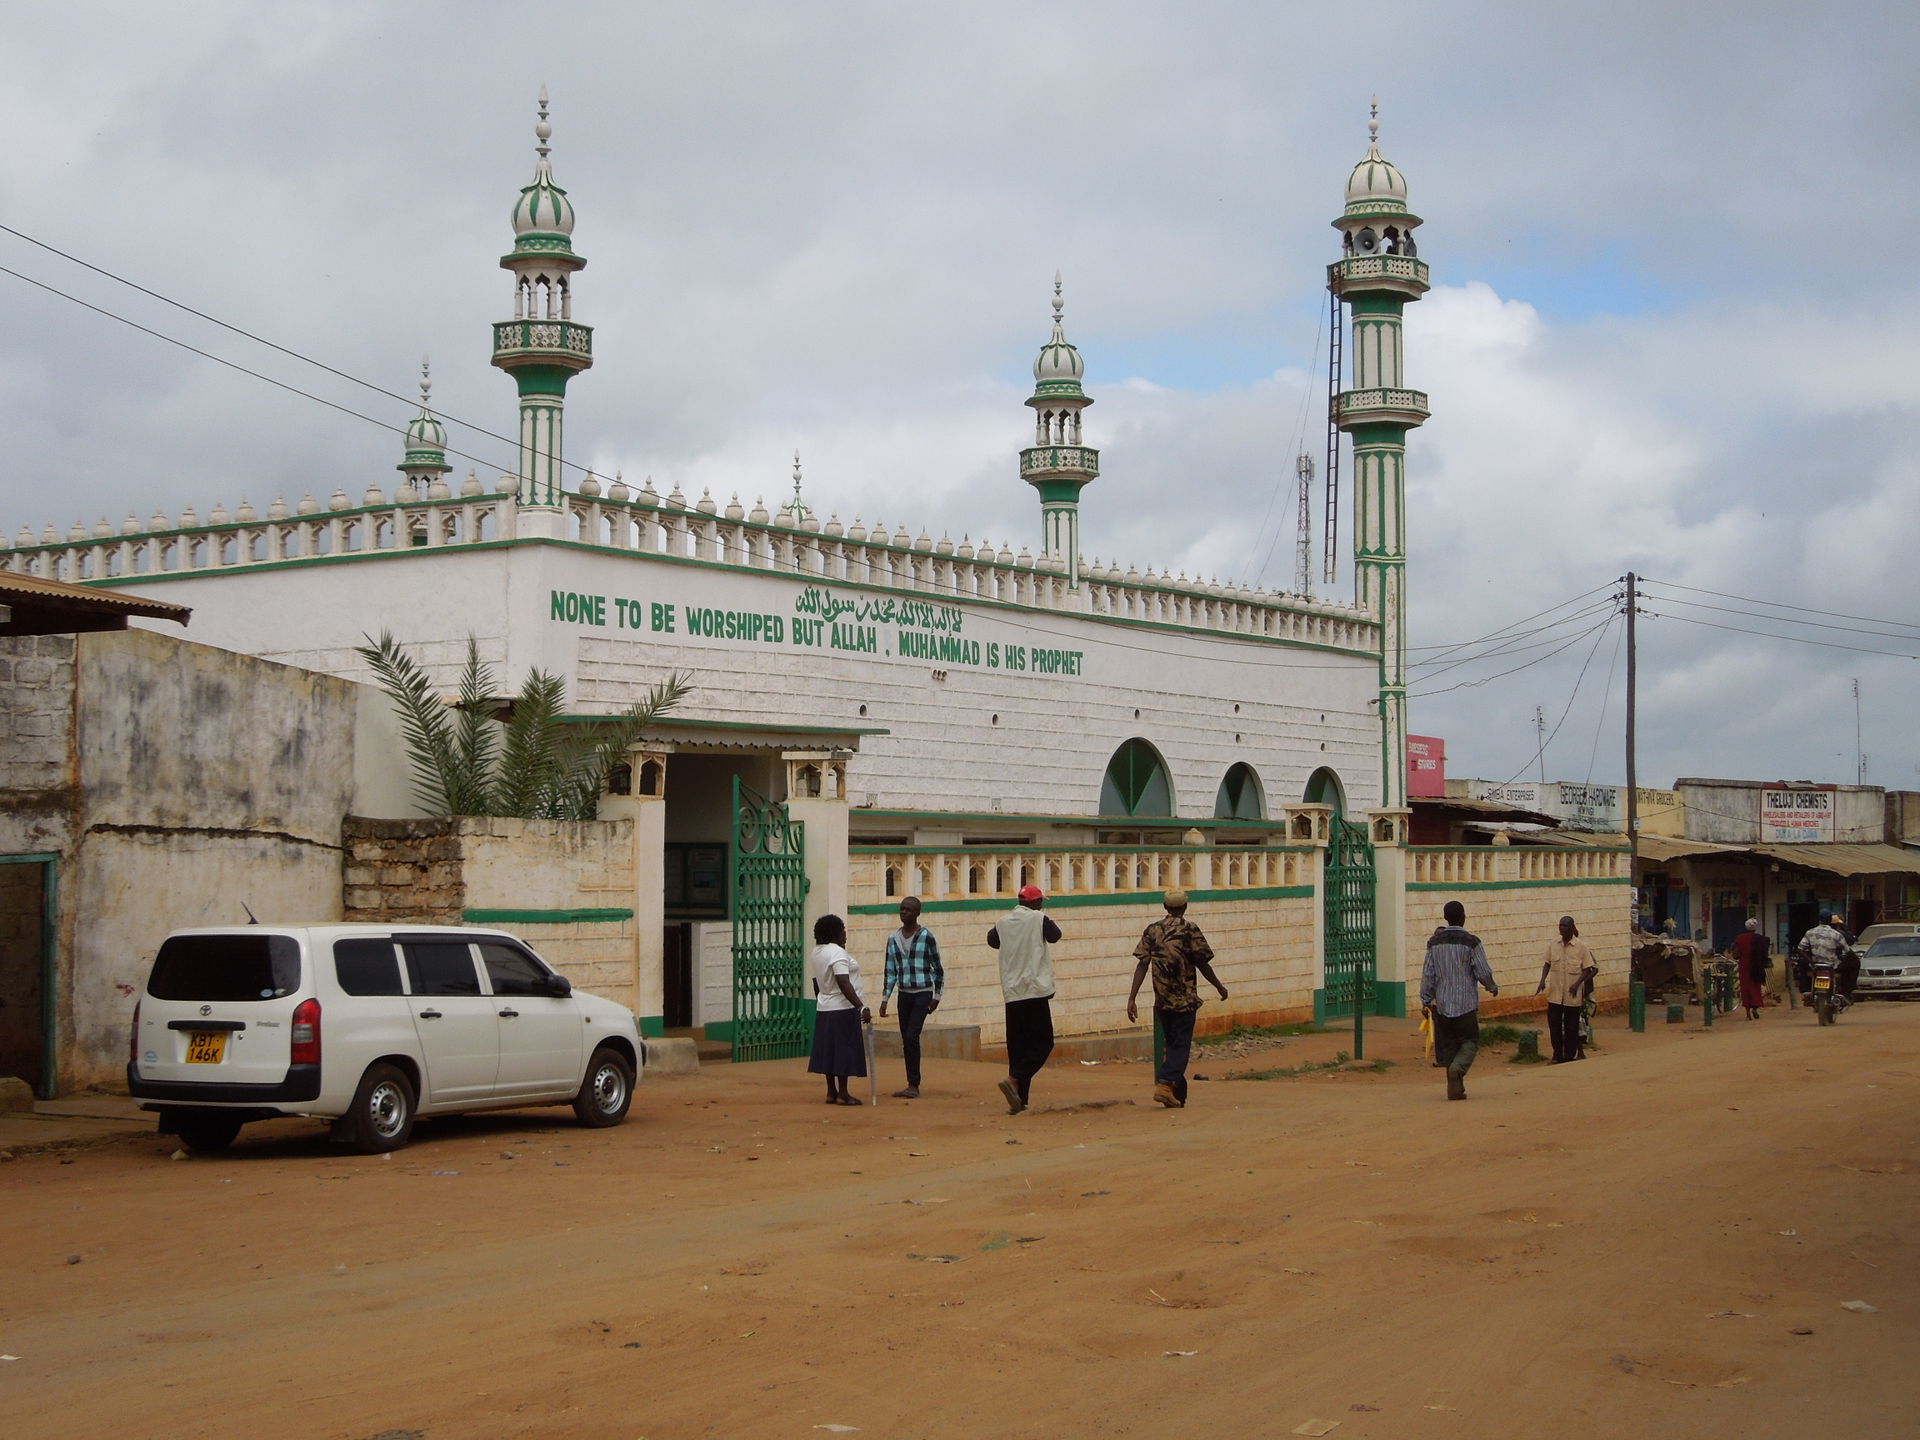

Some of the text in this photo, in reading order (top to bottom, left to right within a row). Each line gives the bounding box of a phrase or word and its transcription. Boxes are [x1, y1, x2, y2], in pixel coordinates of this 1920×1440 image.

[551, 590, 606, 626] NONE
[614, 598, 641, 629] TO
[651, 602, 675, 633] BE
[685, 606, 784, 643] WORSHIPED
[792, 617, 824, 647] BUT
[899, 631, 980, 666] MUHAMMAD
[986, 642, 1000, 668] IS
[1005, 644, 1026, 671] HIS
[1031, 648, 1084, 676] PROPHET
[1766, 792, 1828, 809] THELUJI CHEMISTS
[190, 1033, 215, 1047] KBT
[189, 1048, 220, 1062] 146K
